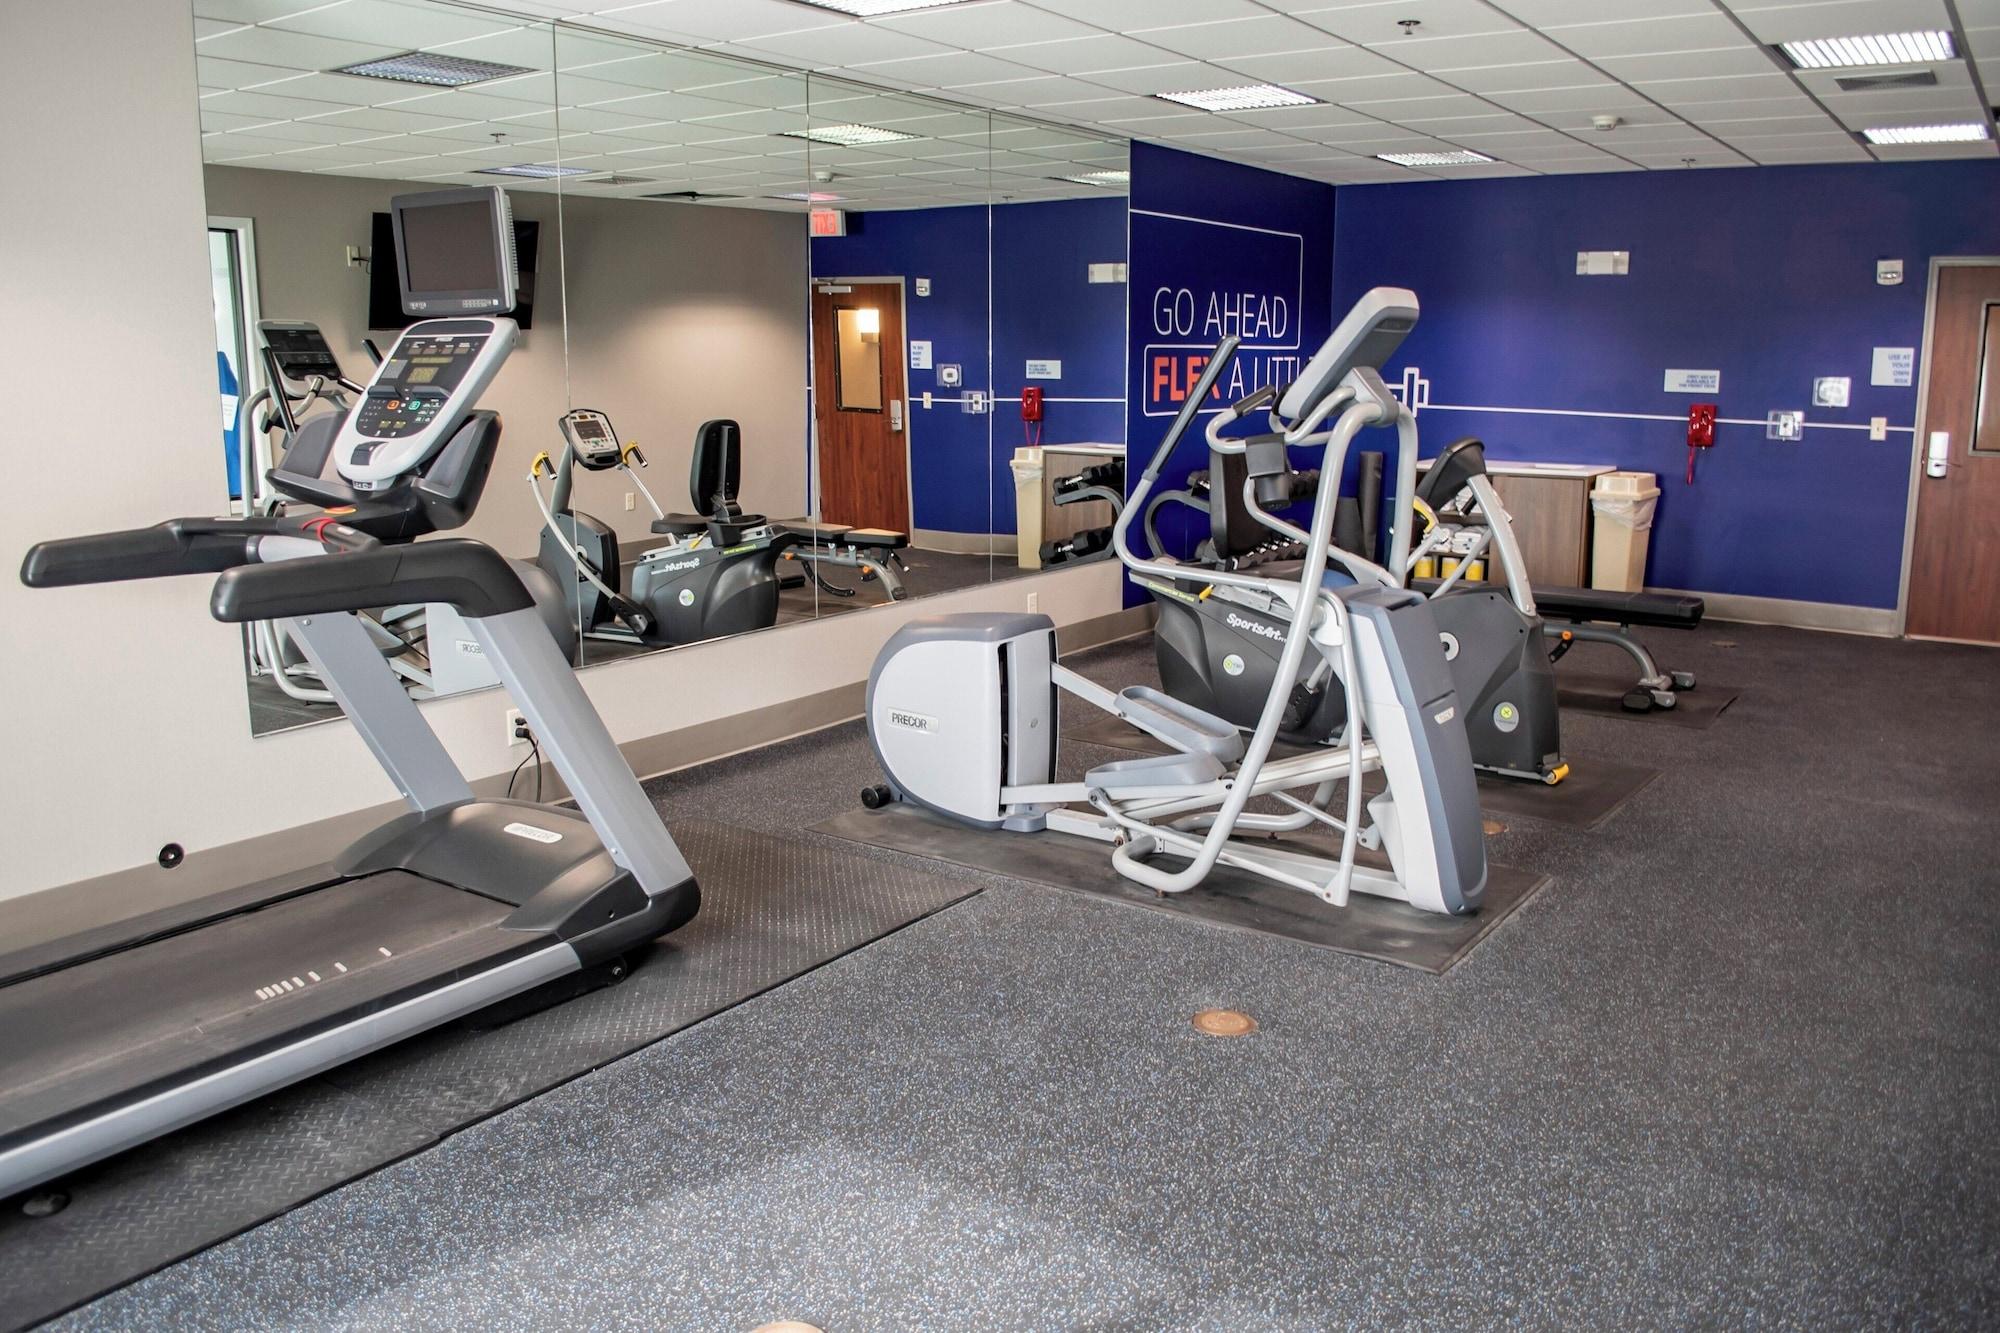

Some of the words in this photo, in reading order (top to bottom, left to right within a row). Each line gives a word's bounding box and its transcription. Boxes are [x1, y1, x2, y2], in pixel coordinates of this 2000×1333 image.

[1153, 286, 1195, 336] GO
[1203, 291, 1288, 339] AHEAD
[1227, 356, 1245, 399] A
[1226, 612, 1281, 641] SportsArt
[891, 712, 927, 729] PRECOR
